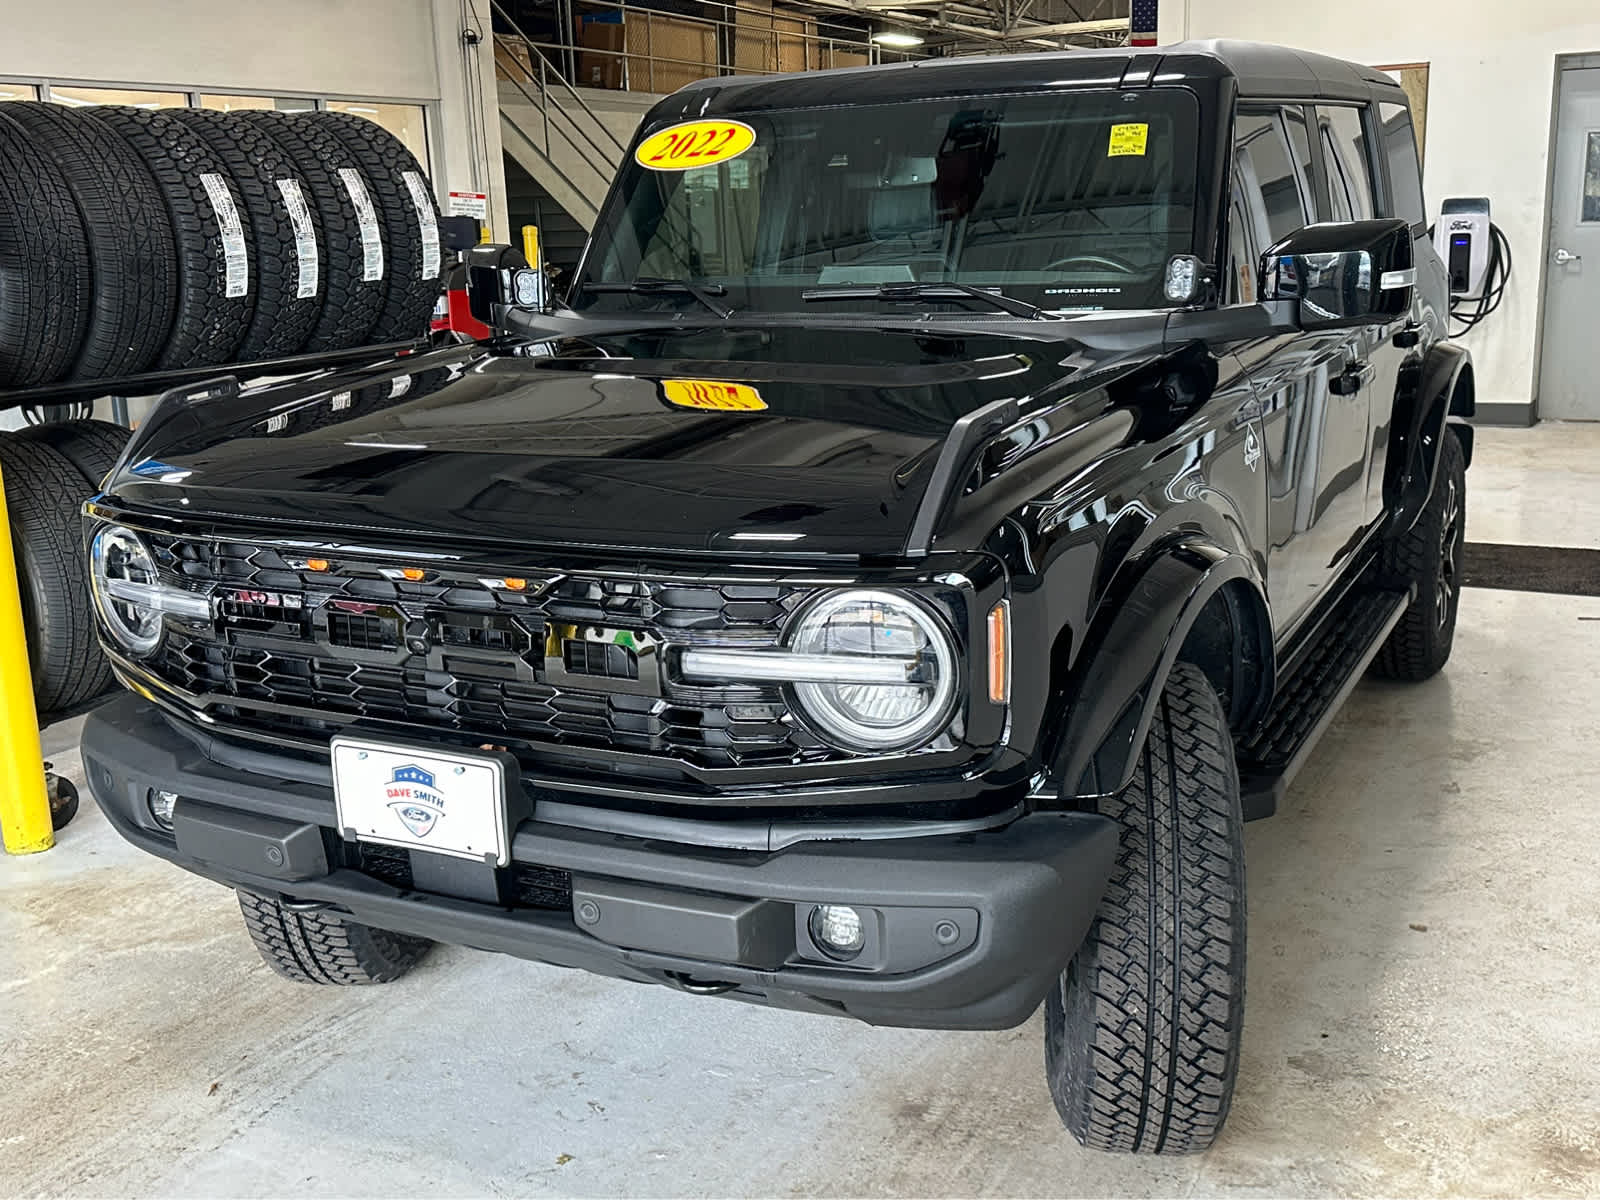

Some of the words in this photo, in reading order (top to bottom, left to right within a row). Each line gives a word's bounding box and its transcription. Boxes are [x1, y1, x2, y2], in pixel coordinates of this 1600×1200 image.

[648, 128, 736, 161] 2022
[1450, 220, 1473, 230] Ford
[386, 788, 411, 799] DAVE
[413, 789, 444, 808] SMITH
